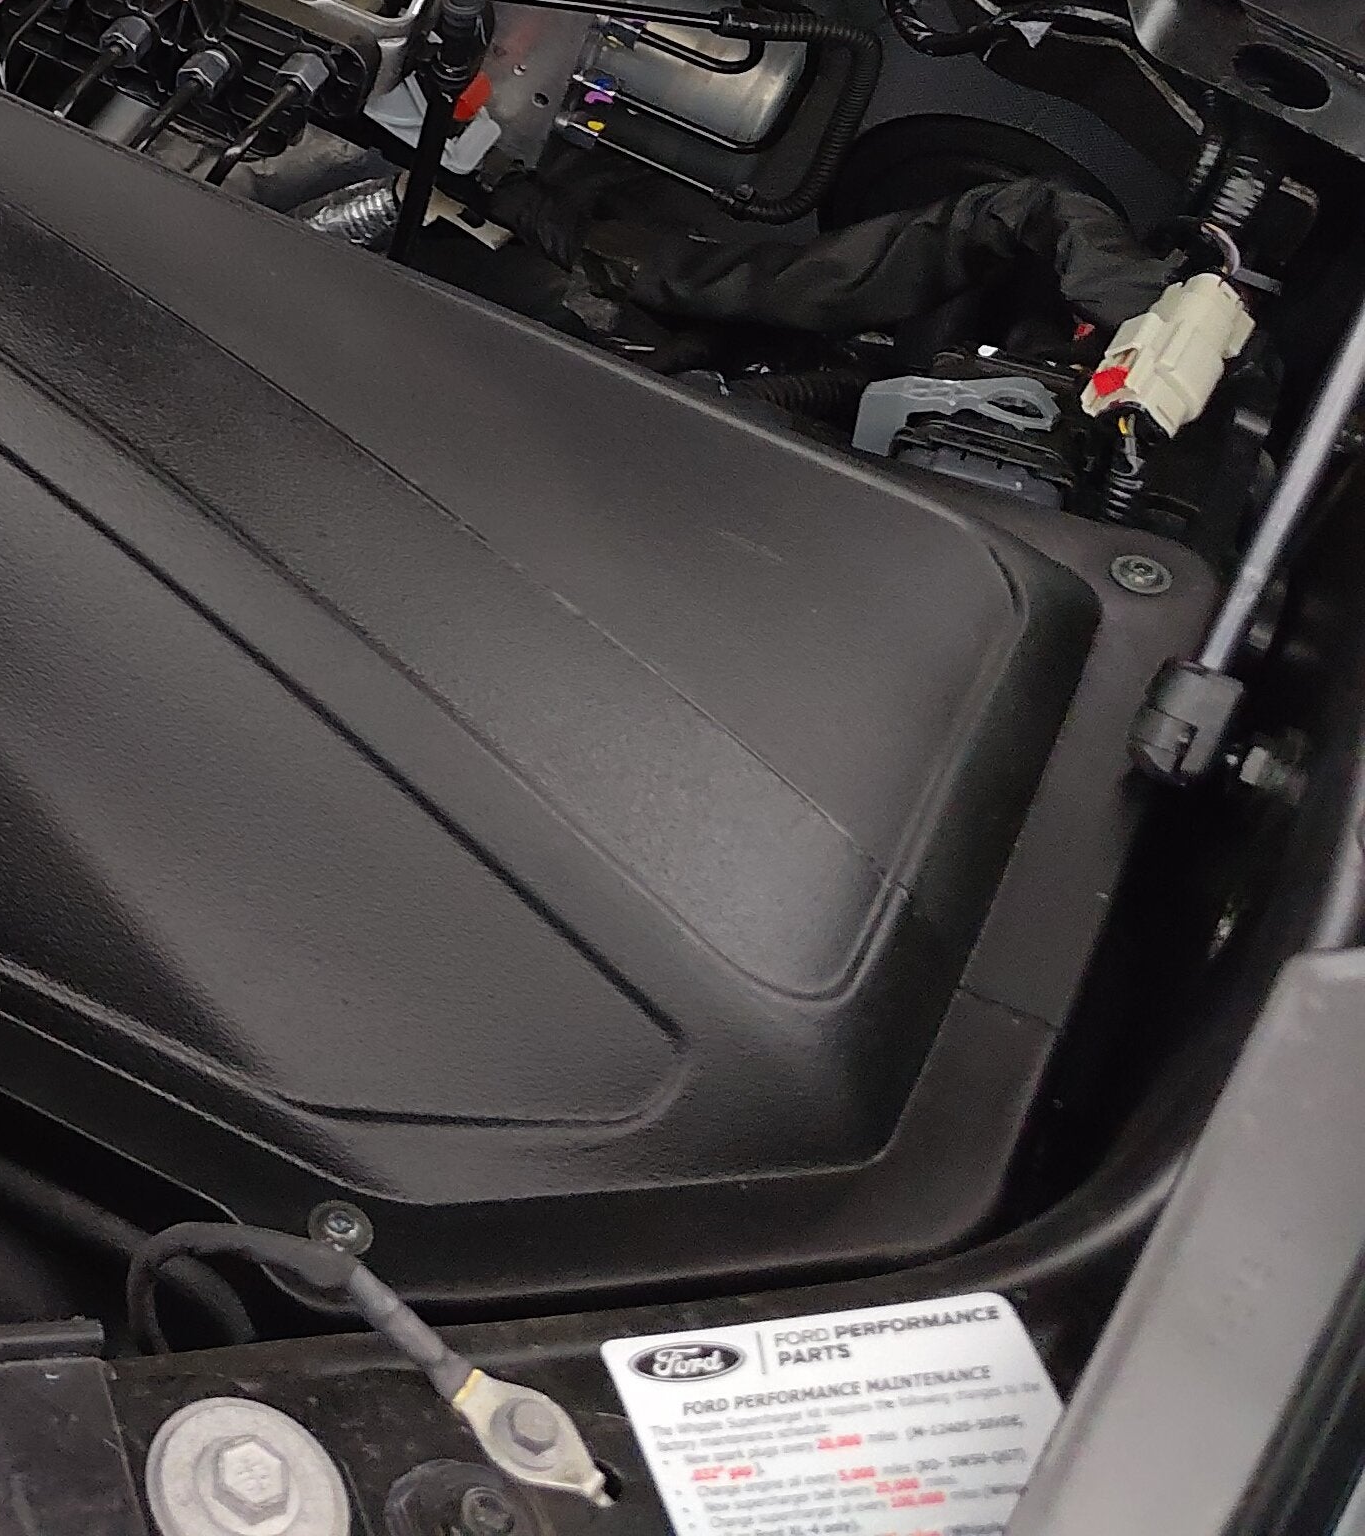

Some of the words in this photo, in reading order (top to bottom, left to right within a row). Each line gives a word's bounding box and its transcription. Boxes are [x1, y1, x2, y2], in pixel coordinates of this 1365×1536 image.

[774, 1327, 831, 1347] FORD
[834, 1304, 1000, 1340] PERFORMANCE
[778, 1343, 851, 1368] PARTS
[682, 1397, 730, 1416] FORD
[734, 1380, 862, 1410] PERFORMANCE
[865, 1364, 992, 1393] MAINTENANCE
